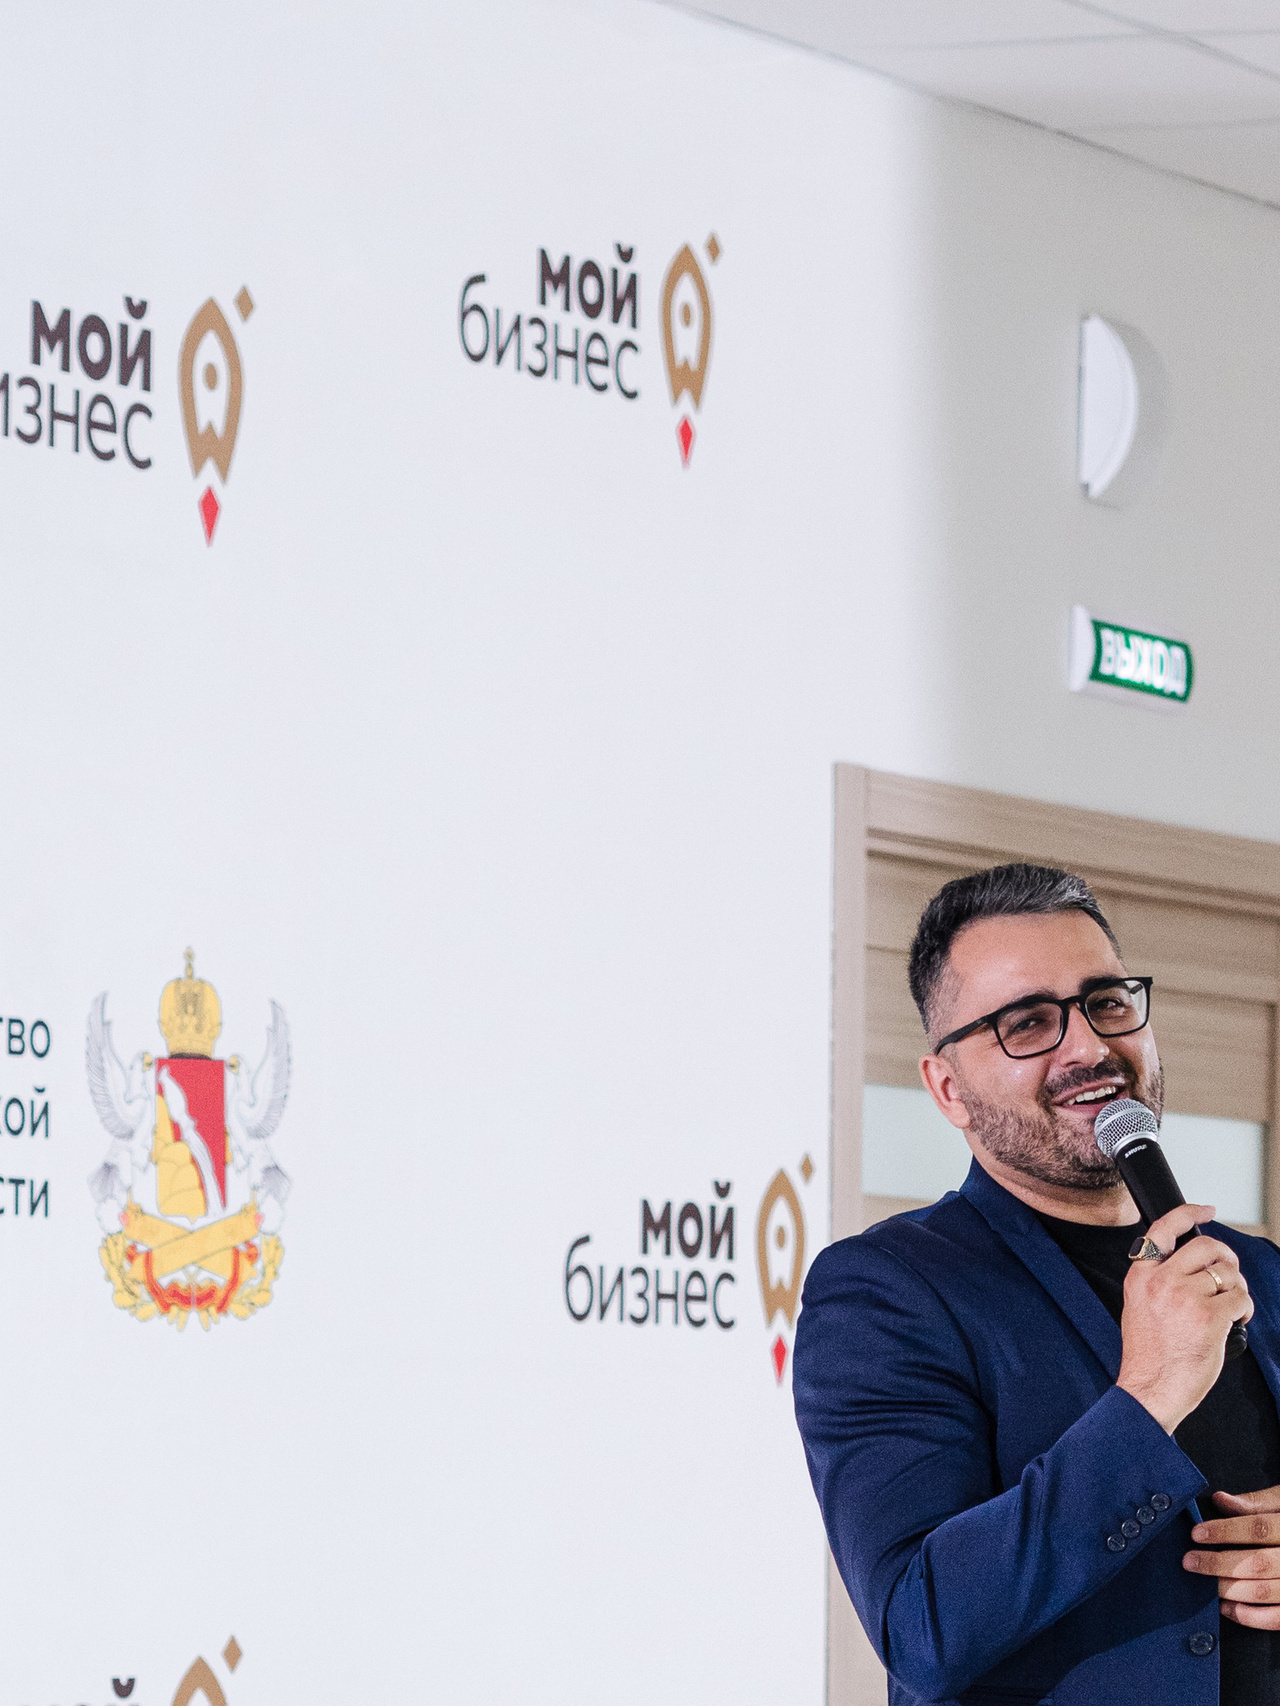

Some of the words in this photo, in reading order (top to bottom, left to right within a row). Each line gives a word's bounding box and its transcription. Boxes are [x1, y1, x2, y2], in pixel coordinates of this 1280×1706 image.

[538, 243, 638, 330] мой
[31, 295, 152, 393] мой
[459, 273, 639, 401] бизнес
[1100, 628, 1186, 697] ВЫХОД
[0, 1017, 51, 1059] ВО
[0, 1085, 50, 1138] ОЙ
[641, 1180, 735, 1262] мой
[564, 1234, 736, 1331] бизнес
